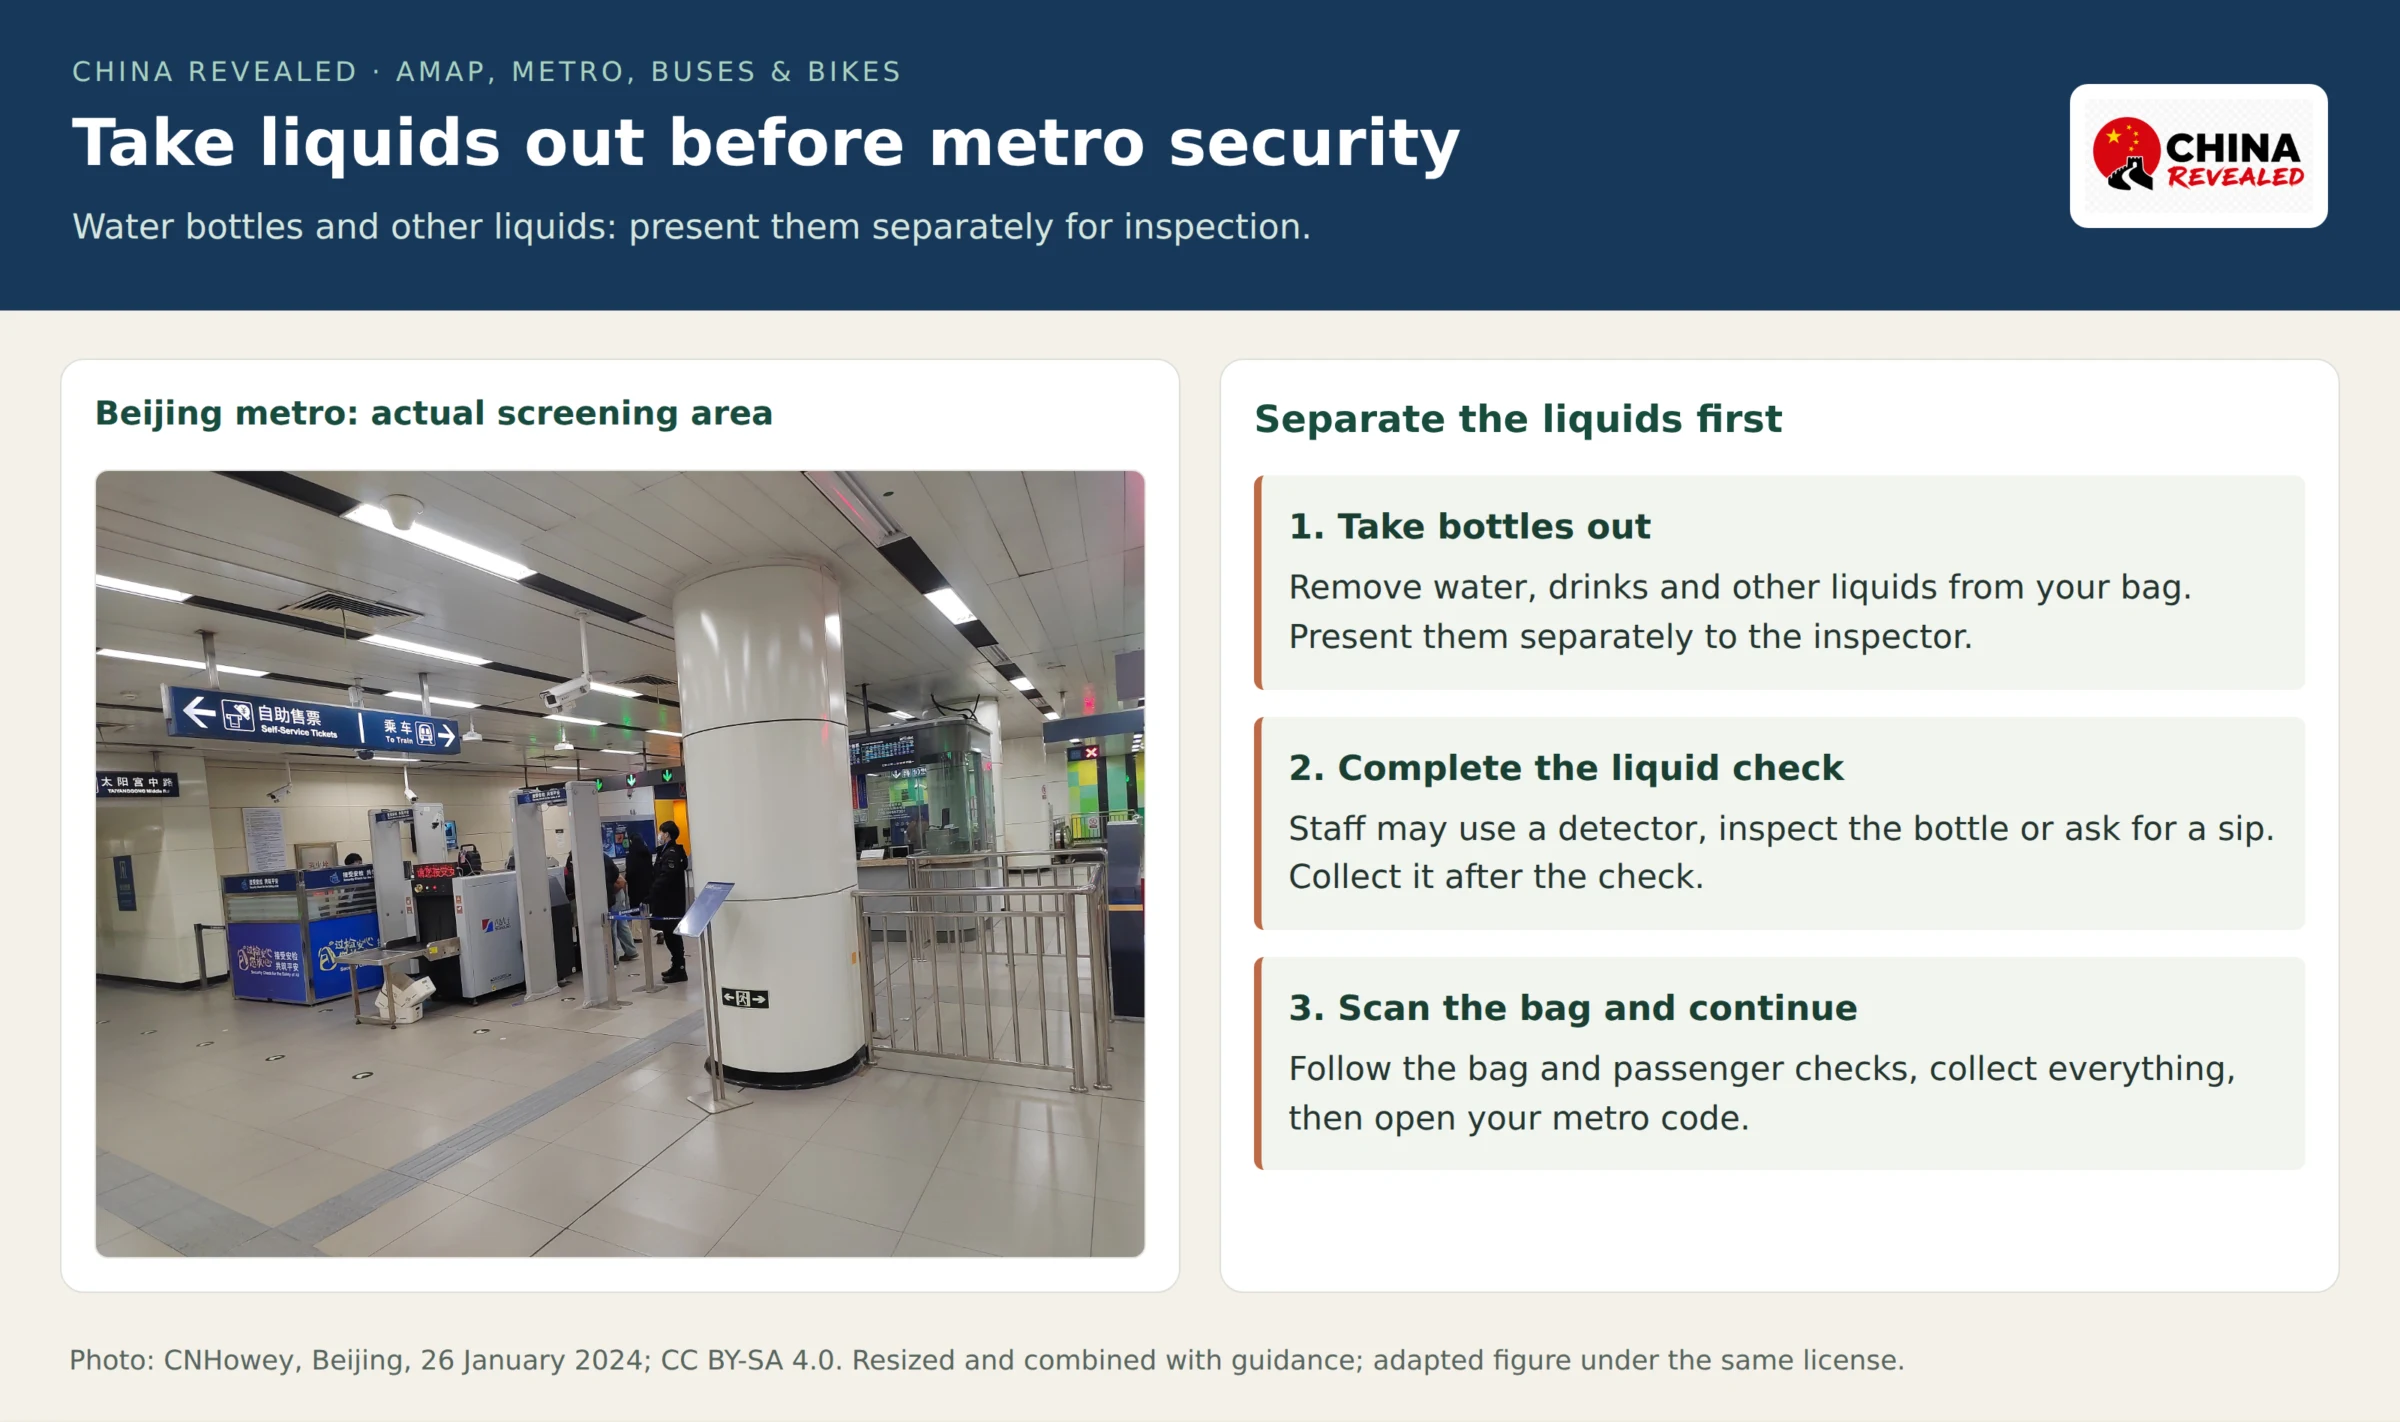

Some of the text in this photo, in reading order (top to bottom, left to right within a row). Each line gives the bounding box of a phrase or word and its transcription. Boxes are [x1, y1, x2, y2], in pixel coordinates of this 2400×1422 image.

[258, 704, 322, 727] 自助售票
[261, 725, 338, 739] Self-Service Tickets
[101, 776, 173, 788] 太阳宫中路
[274, 951, 298, 960] 接受安检
[276, 962, 299, 972] 共筑平安
